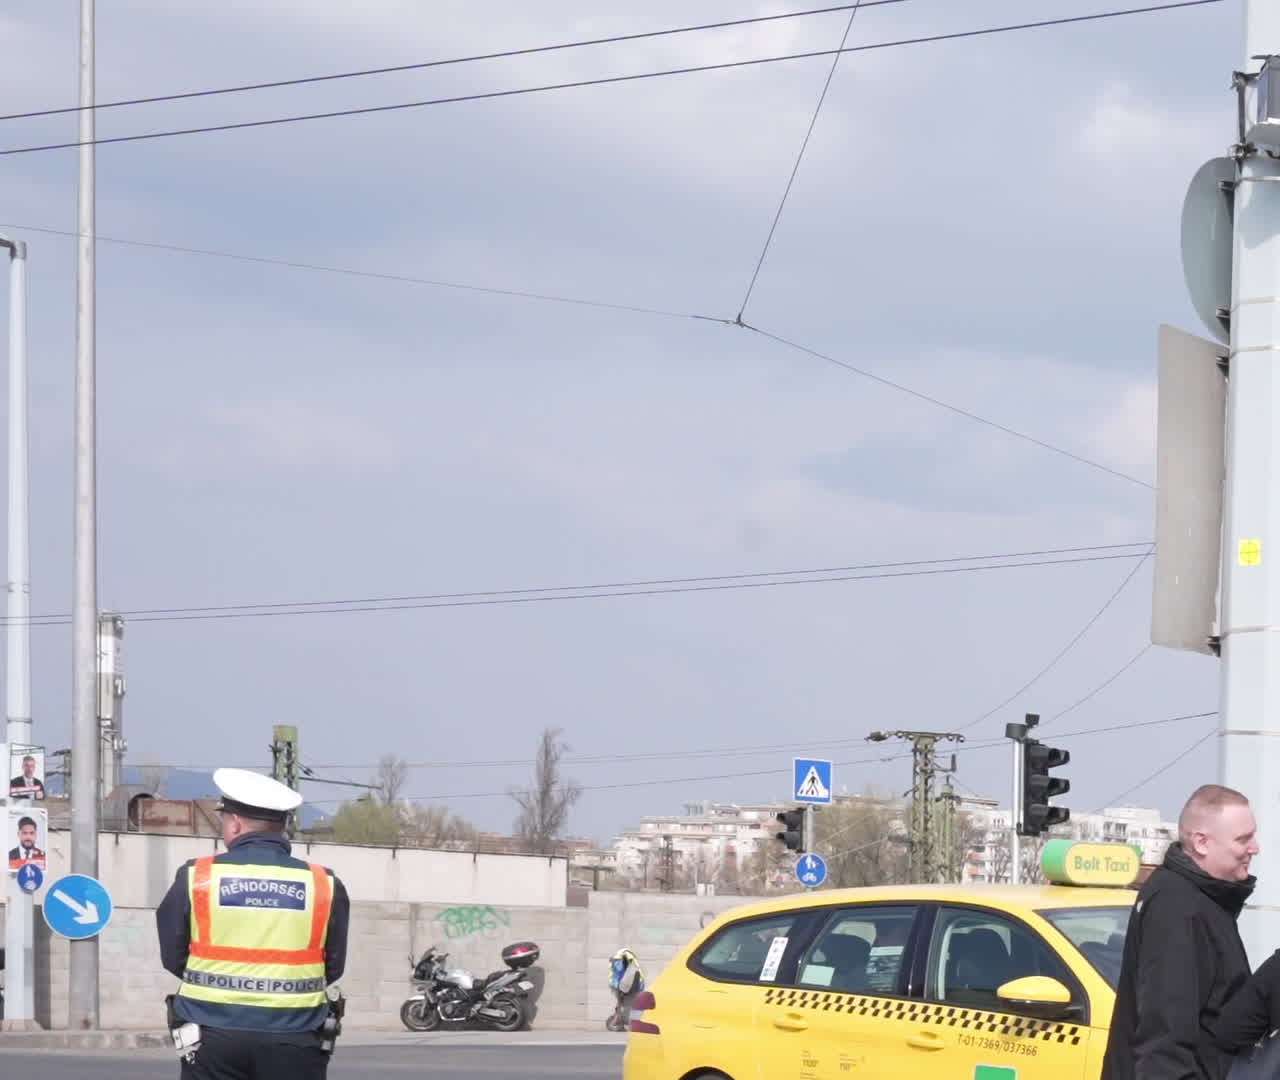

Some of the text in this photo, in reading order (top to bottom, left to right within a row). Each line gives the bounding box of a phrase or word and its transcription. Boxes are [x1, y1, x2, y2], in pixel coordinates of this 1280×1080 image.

[1074, 856, 1130, 872] Bolt Taxi
[245, 897, 280, 907] POLICE
[207, 975, 265, 991] POLICE
